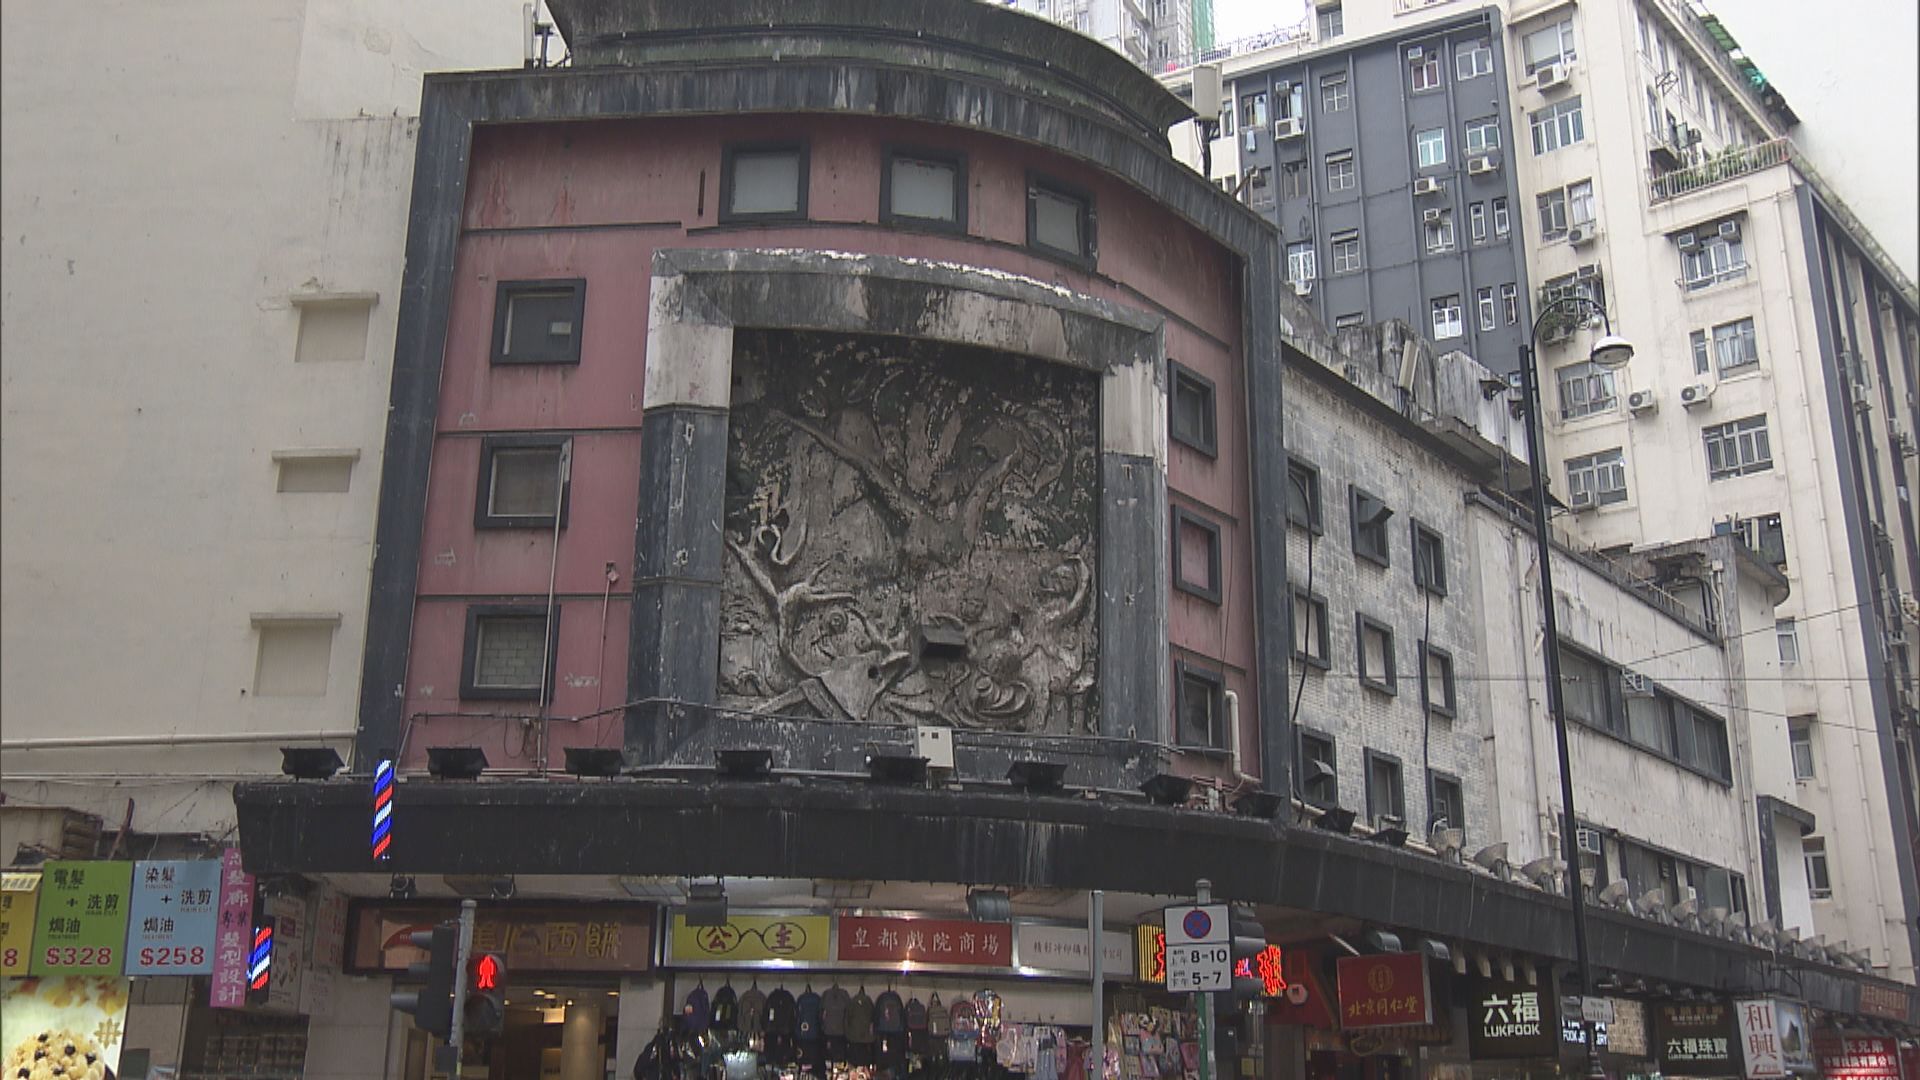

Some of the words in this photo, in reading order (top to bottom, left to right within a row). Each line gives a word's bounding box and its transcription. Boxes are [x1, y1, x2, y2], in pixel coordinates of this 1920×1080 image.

[54, 868, 85, 886] 電髮
[145, 866, 175, 883] 染髮
[87, 894, 119, 910] 洗剪
[181, 888, 212, 905] 洗剪
[46, 946, 112, 967] $328
[140, 946, 204, 967] $258
[1191, 950, 1227, 963] 8-10
[1349, 995, 1418, 1017] 北京同仁堂
[1483, 992, 1540, 1023] 六福
[1484, 1023, 1540, 1037] LUKFOOK
[1744, 1004, 1777, 1060] 和興
[1667, 1037, 1728, 1054] 六福珠寶
